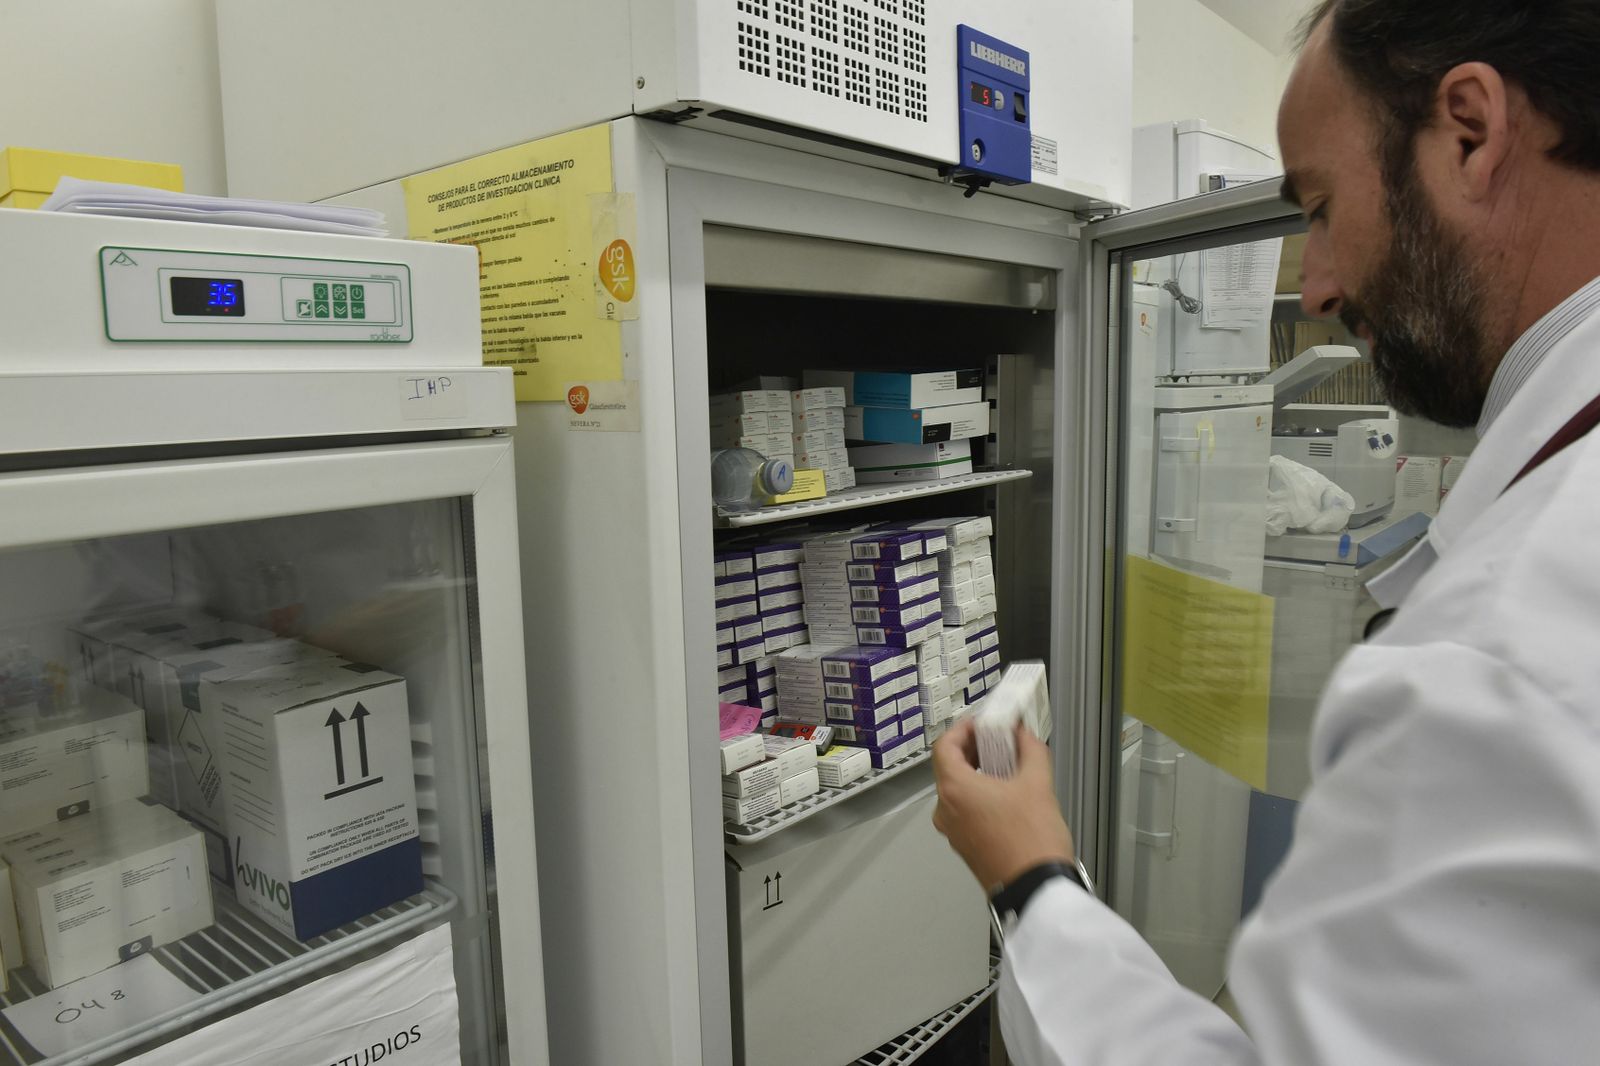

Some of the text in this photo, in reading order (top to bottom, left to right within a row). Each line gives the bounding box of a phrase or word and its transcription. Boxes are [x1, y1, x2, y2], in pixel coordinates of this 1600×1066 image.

[970, 41, 1026, 77] LIEBHERR
[982, 89, 989, 105] 5
[428, 159, 574, 203] CONSEJOS PARA EL CORRECTO ALMACENAMIENTO
[438, 176, 561, 213] DE PRODUCTOS DE INVESTIGACION CLINICA
[606, 246, 629, 293] gsk
[351, 306, 365, 314] Set
[570, 390, 586, 408] gsk
[778, 464, 786, 482] A
[307, 830, 327, 841] PACKED
[332, 818, 362, 832] COMPLIANCE
[307, 848, 340, 862] COMBINATION
[340, 839, 362, 850] PACKAGE
[362, 834, 372, 842] ARE
[372, 830, 385, 838] USED
[392, 822, 409, 831] TESTED
[317, 839, 348, 854] COMPLIANCE
[361, 828, 375, 837] WHEN
[384, 820, 398, 829] PARTS
[330, 823, 364, 838] INSTRUCTIONS
[301, 868, 309, 876] DO
[320, 860, 333, 868] PACK
[344, 852, 352, 860] ICE
[352, 848, 364, 856] INTO
[364, 844, 373, 852] THE
[374, 839, 387, 848] INNER
[388, 829, 416, 843] RECEPTACLE
[330, 1024, 422, 1066] TUDIOS
